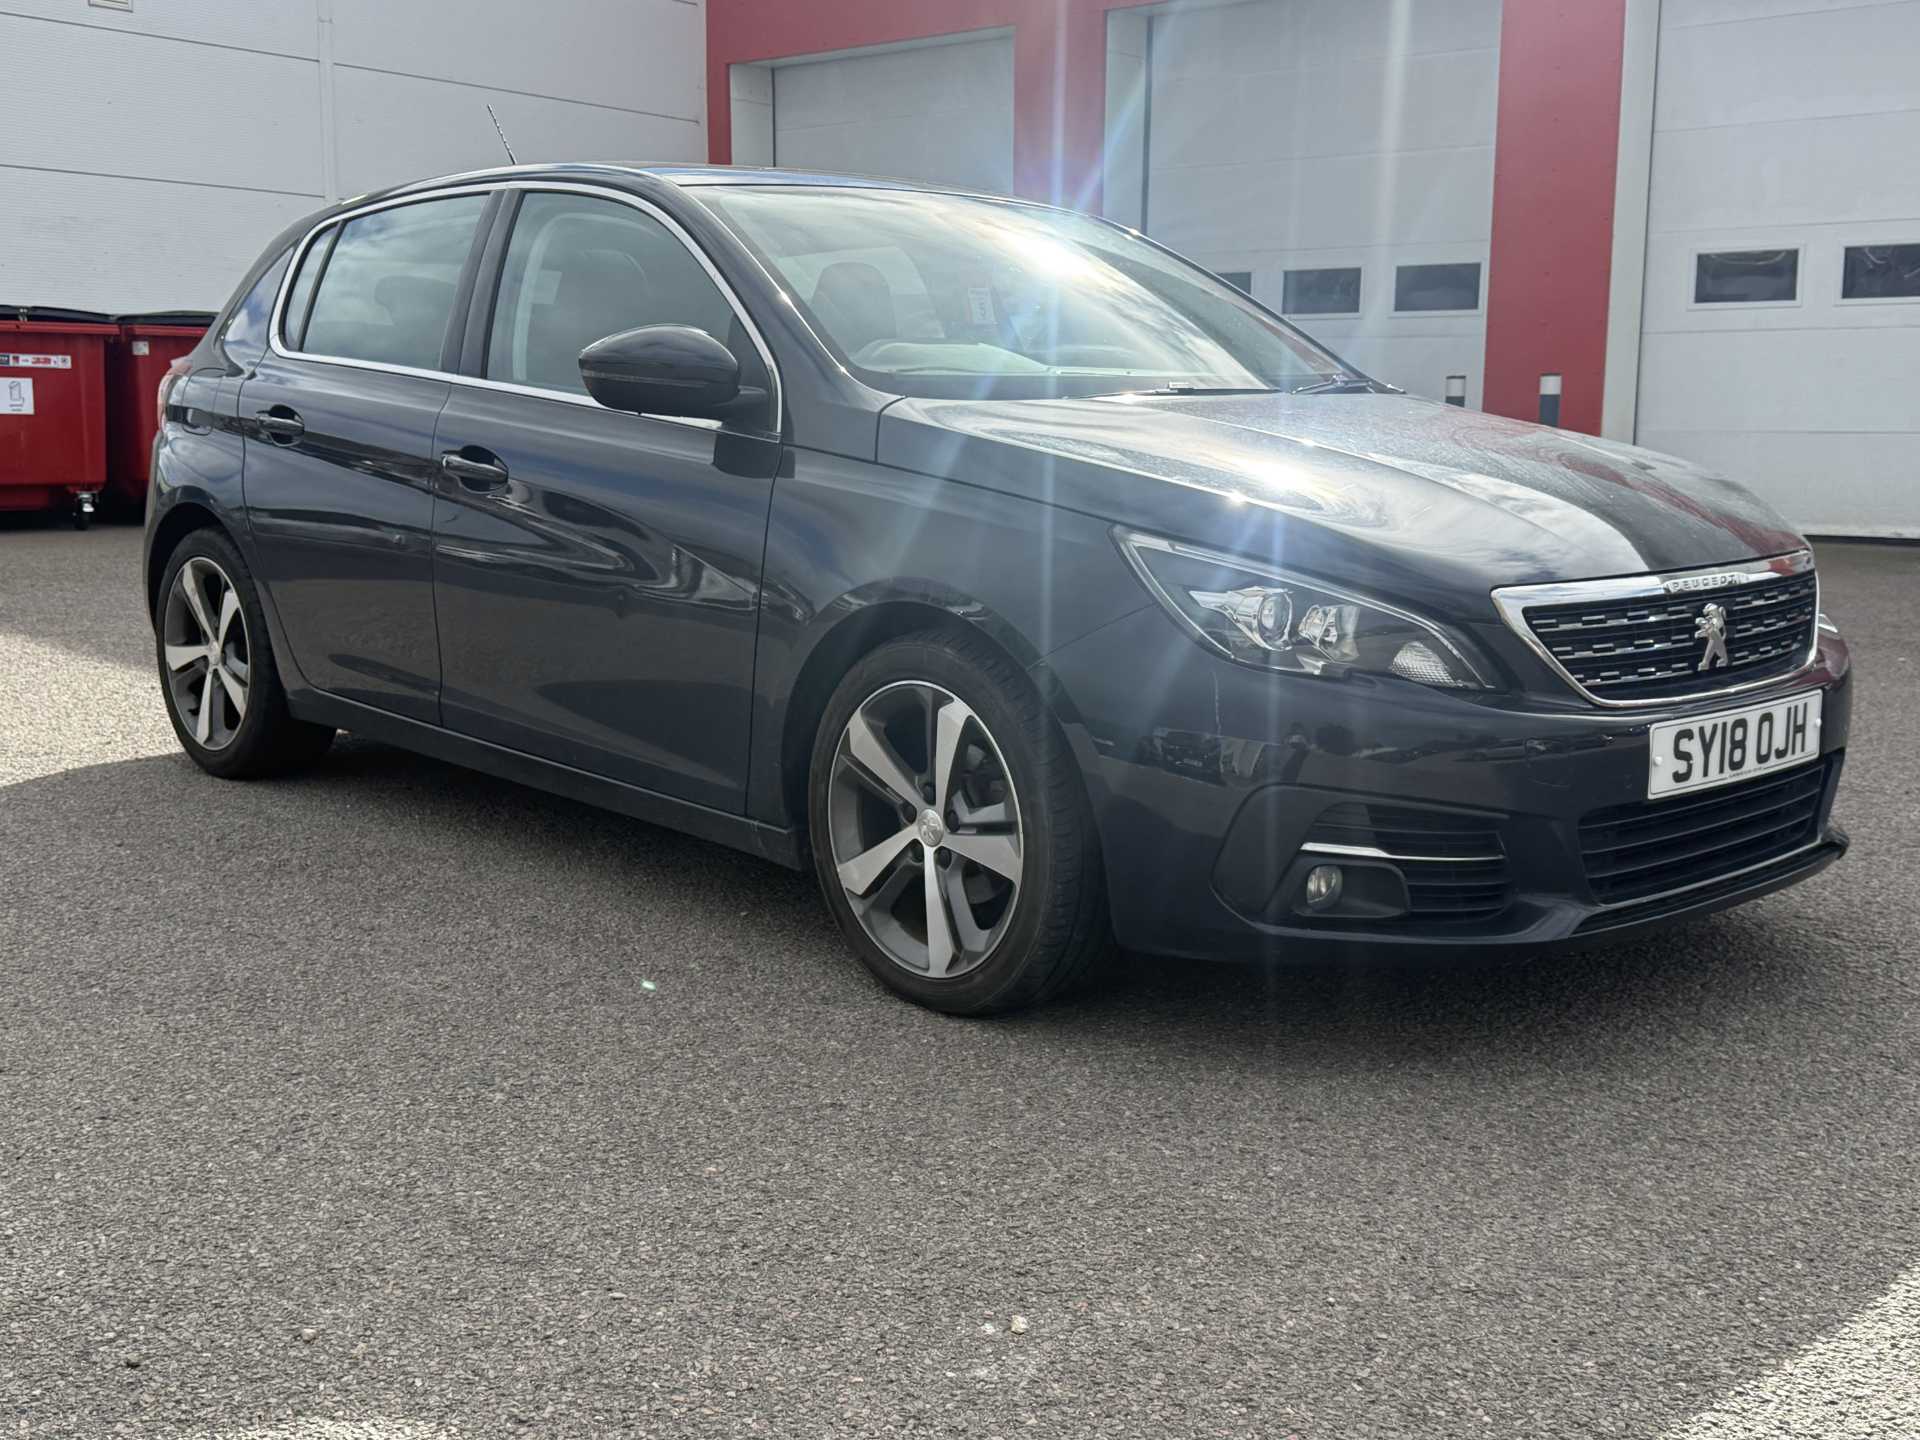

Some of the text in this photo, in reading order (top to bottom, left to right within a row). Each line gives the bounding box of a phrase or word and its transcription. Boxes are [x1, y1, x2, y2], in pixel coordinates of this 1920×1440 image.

[1672, 574, 1736, 590] PEUGEOT
[1672, 702, 1808, 784] SY18 OJH
